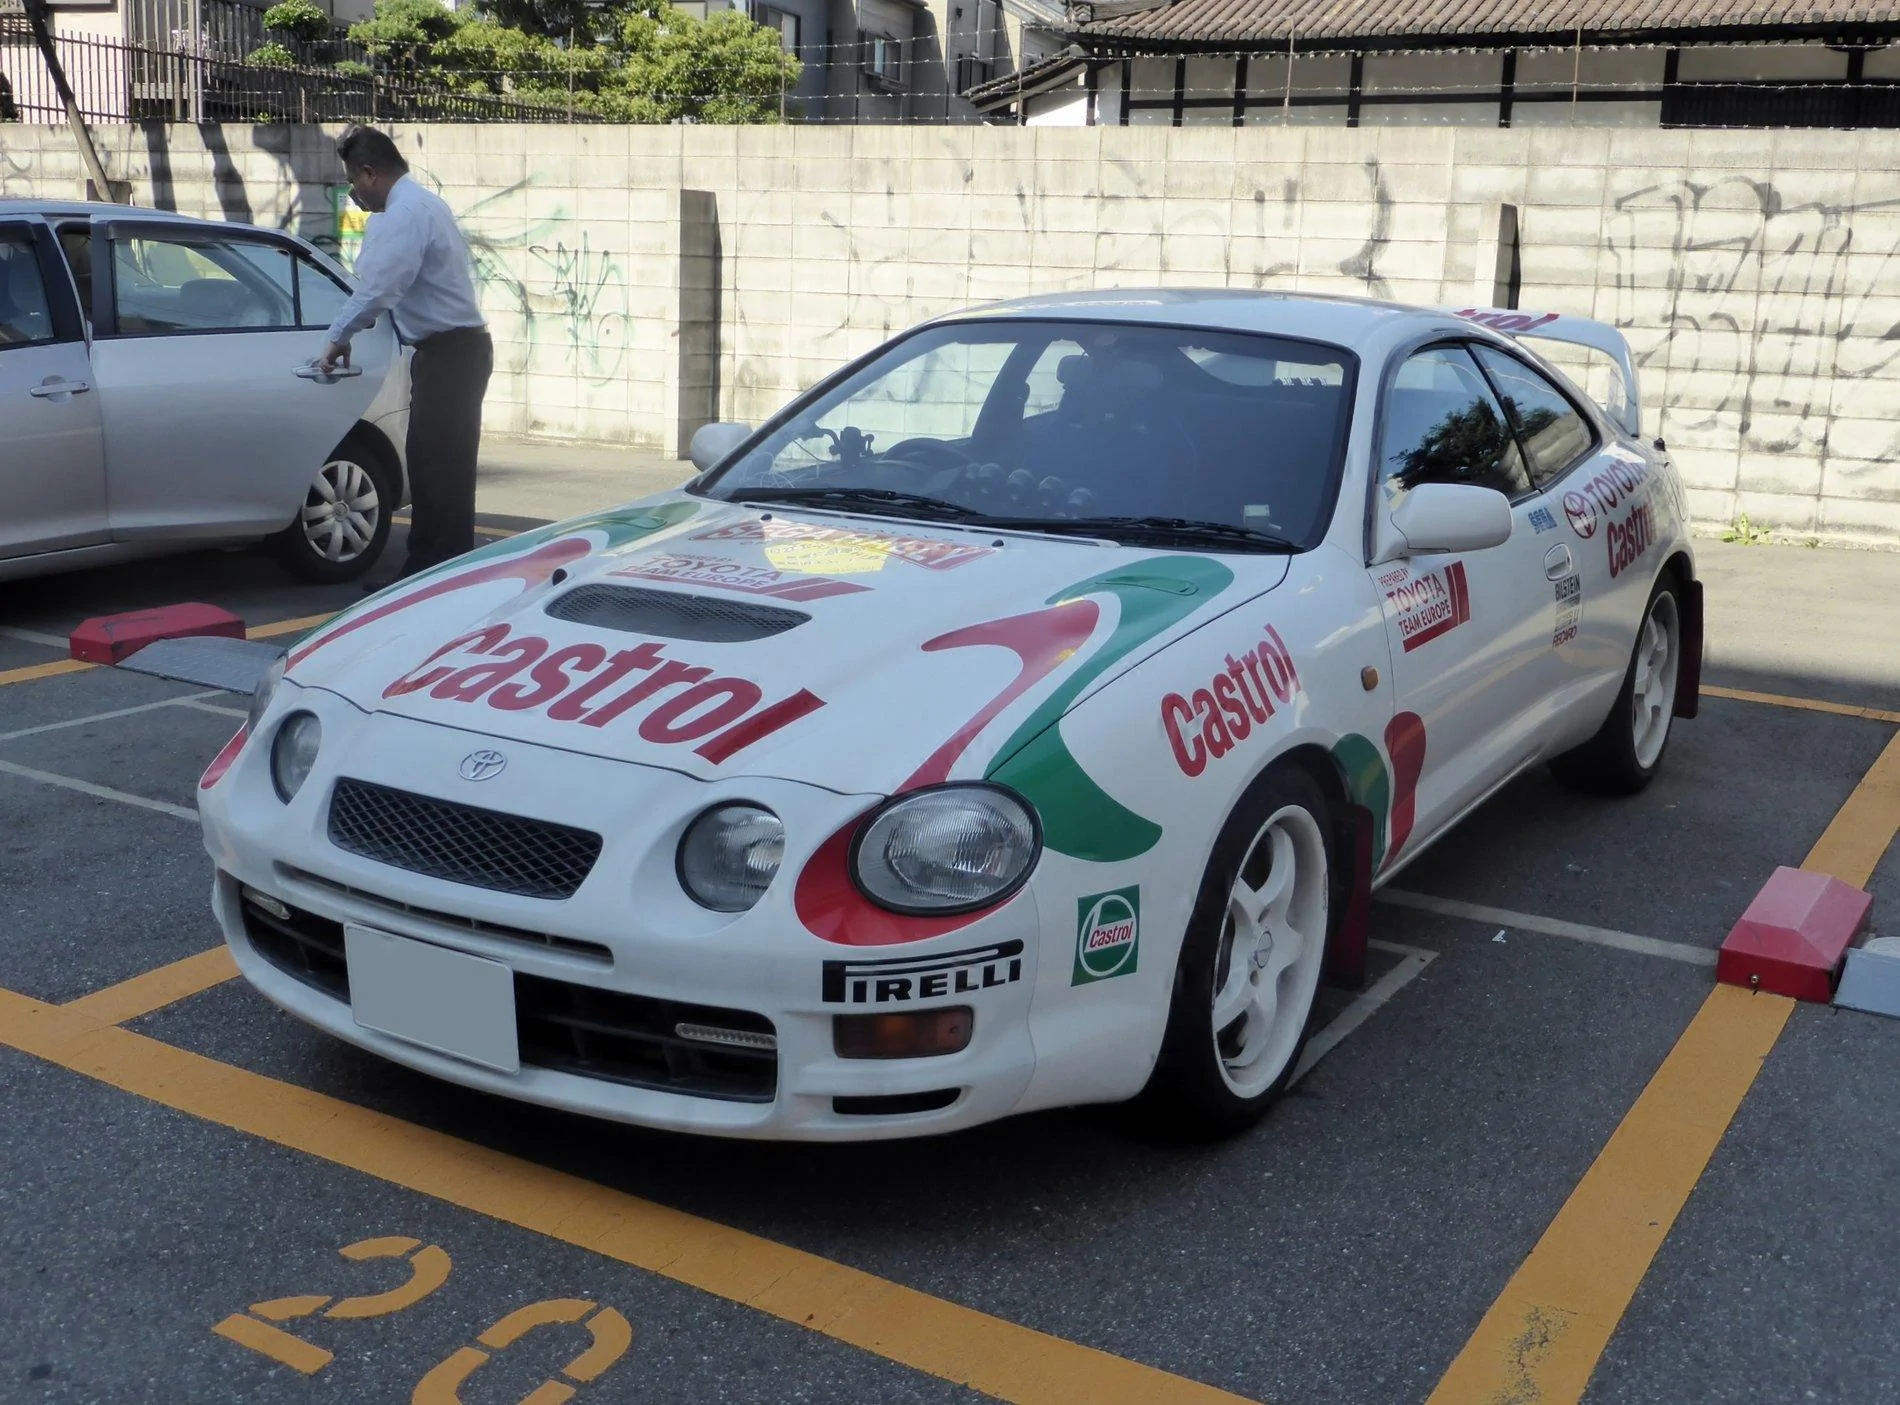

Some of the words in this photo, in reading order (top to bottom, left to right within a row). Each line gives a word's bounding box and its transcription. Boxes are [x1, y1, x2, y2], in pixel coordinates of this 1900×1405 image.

[1584, 459, 1648, 515] TOYOTA
[1528, 507, 1558, 534] SEGA
[1607, 489, 1656, 578] Castrol
[646, 556, 783, 581] TOYOTA
[681, 571, 769, 588] EUROPE
[1386, 572, 1446, 616] TOYOTA
[1398, 613, 1422, 636] TEAM
[1420, 599, 1451, 626] EUROPE
[382, 623, 828, 765] Castrol
[1161, 623, 1301, 777] Castrol
[1089, 921, 1134, 949] Castrol
[822, 938, 1024, 1003] PIRELLI
